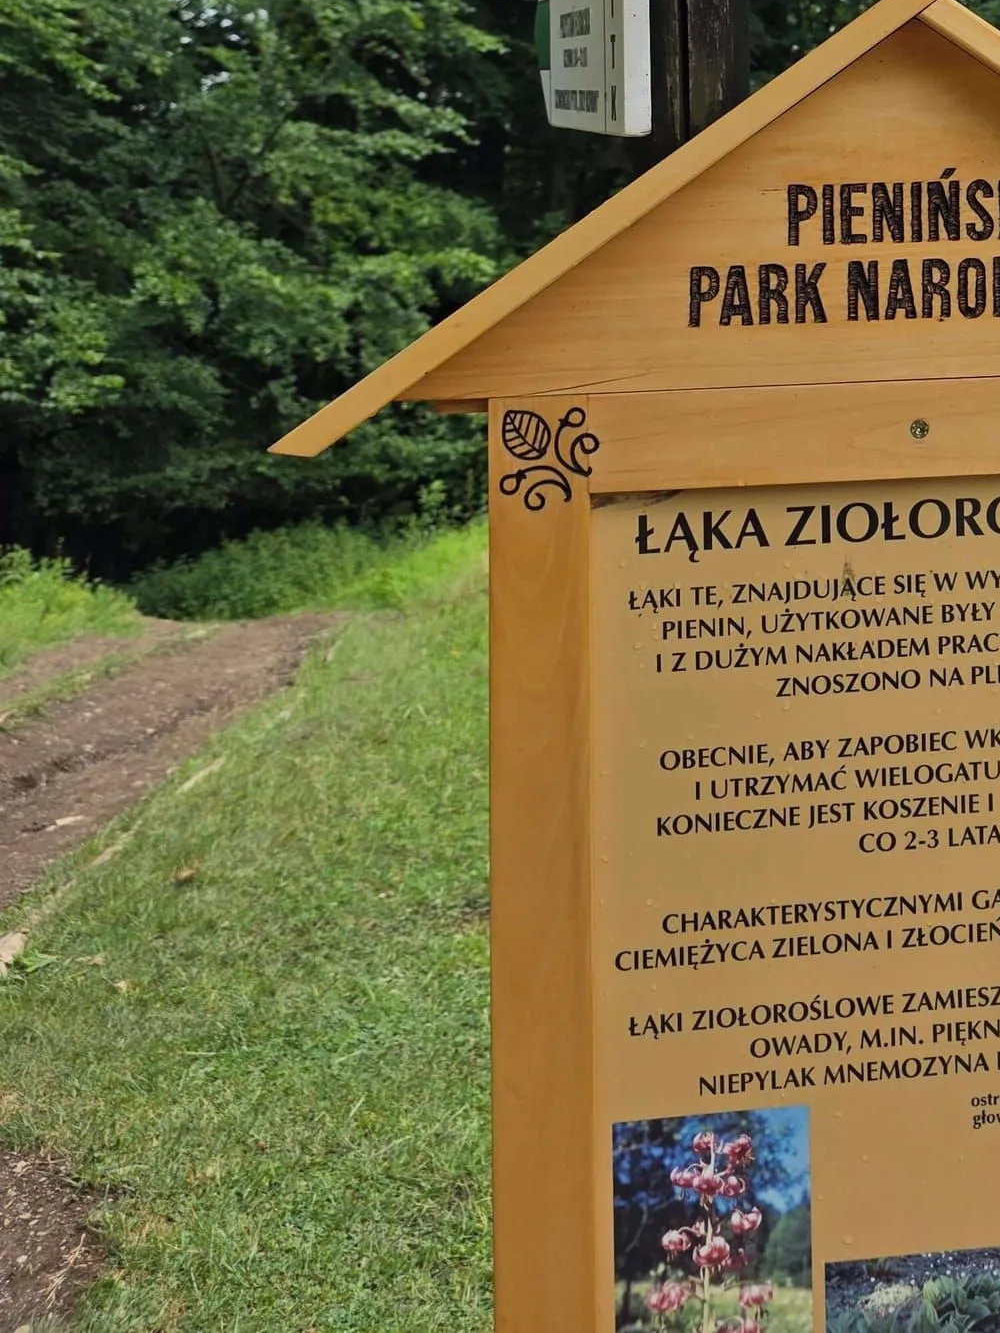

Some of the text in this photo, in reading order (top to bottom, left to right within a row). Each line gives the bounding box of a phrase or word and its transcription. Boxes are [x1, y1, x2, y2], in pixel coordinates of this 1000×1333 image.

[688, 263, 827, 328] PARK
[635, 508, 770, 563] ŁĄKA
[628, 588, 680, 611] ŁĄKI
[690, 586, 723, 608] TE,
[732, 576, 885, 604] ZNAJDUJĄCE
[894, 574, 925, 597] SIĘ
[933, 572, 958, 591] W
[663, 617, 751, 640] PIENIN,
[762, 605, 932, 634] UŻYTKOWANE
[942, 602, 995, 623] BYŁY
[655, 654, 663, 673] I
[672, 652, 686, 672] Z
[695, 643, 787, 670] DUŻYM
[796, 638, 930, 663] NAKŁADEM
[776, 670, 921, 697] ZNOSZONO
[930, 667, 964, 687] NA
[660, 744, 774, 771] OBECNIE,
[783, 739, 830, 761] ABY
[838, 731, 957, 757] ZAPOBIEC
[695, 781, 701, 800] I
[711, 765, 846, 799] UTRZYMAĆ
[657, 807, 800, 836] KONIECZNE
[808, 802, 855, 828] JEST
[864, 794, 979, 820] KOSZENIE
[987, 793, 994, 812] I
[859, 832, 896, 853] CO
[905, 829, 939, 850] 2-3
[662, 892, 962, 934] CHARAKTERYSTYCZNYMI
[615, 939, 765, 971] CIEMIĘŻYCA
[772, 931, 879, 958] ZIELONA
[886, 930, 893, 949] I
[629, 1013, 682, 1038] ŁĄKI
[692, 994, 893, 1031] ZIOŁOROŚLOWE
[750, 1032, 851, 1058] OWADY,
[860, 1026, 923, 1049] M.IN.
[699, 1067, 815, 1095] NIEPYLAK
[824, 1053, 989, 1085] MNEMOZYNA
